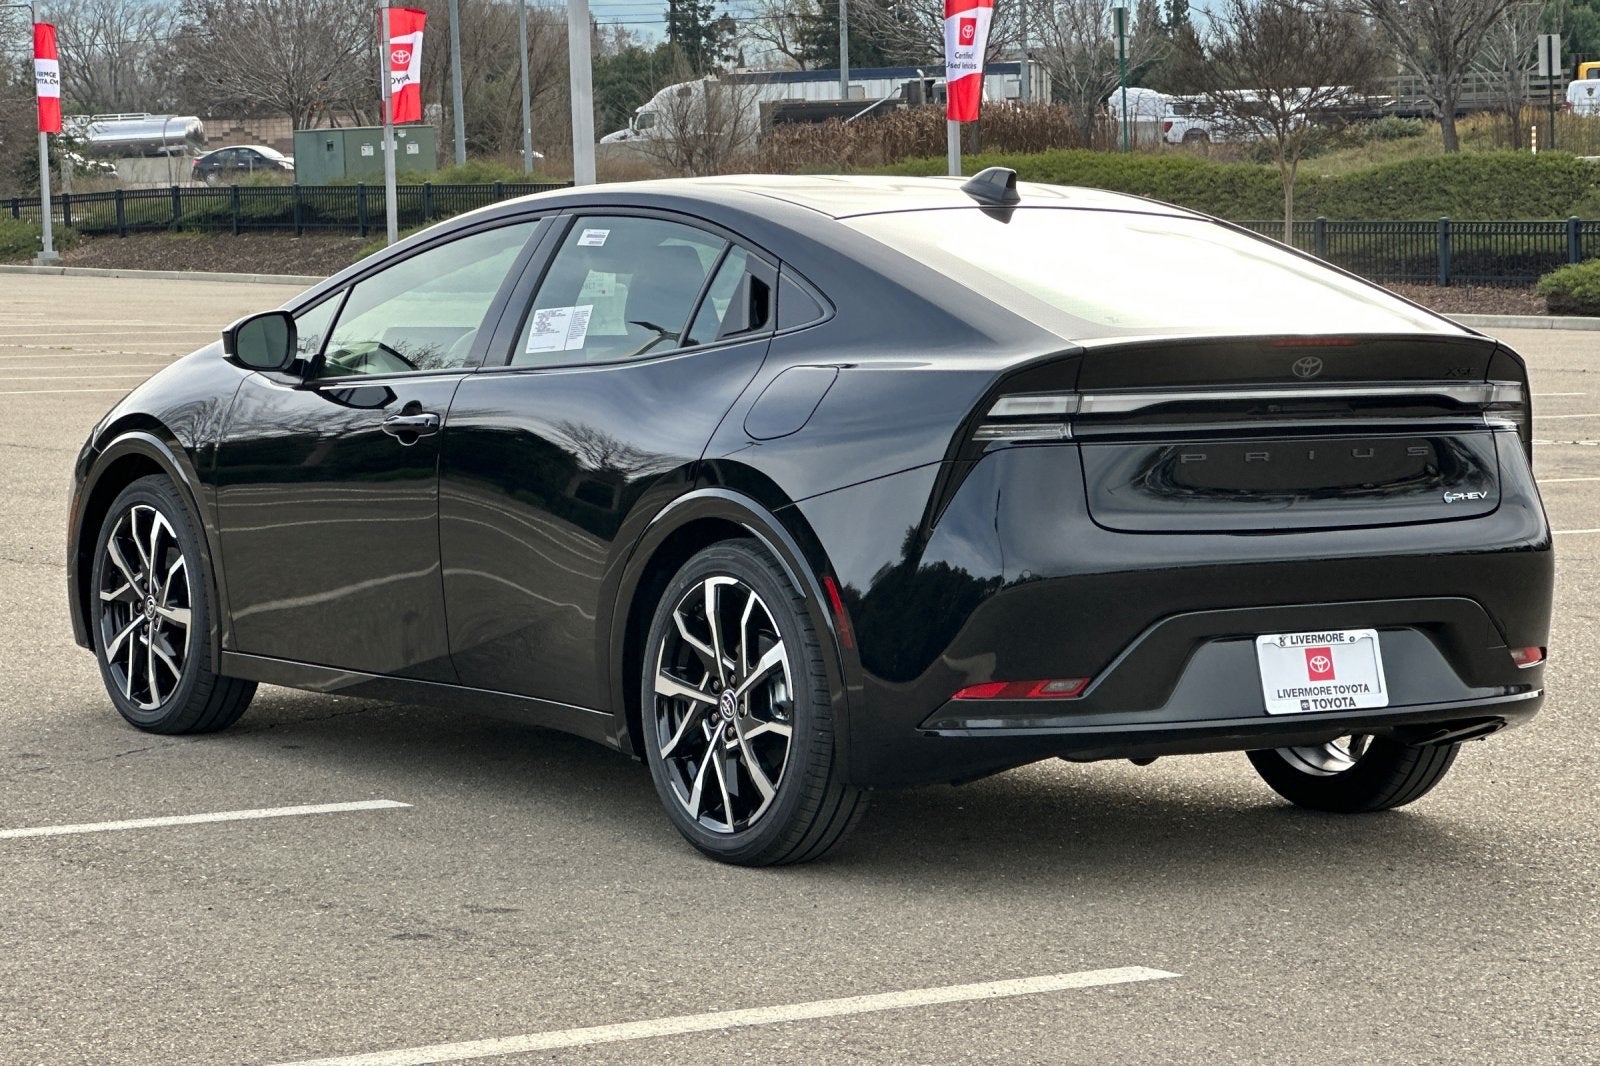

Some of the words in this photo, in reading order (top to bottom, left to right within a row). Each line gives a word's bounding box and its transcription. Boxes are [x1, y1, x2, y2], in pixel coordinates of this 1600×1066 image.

[1179, 446, 1430, 463] PRIUS
[1452, 491, 1488, 500] PHEV
[1290, 633, 1345, 645] LIVERMORE
[1277, 686, 1332, 698] LIVERMORE
[1333, 683, 1370, 694] TOYOTA
[1311, 697, 1357, 710] TOYOTA
